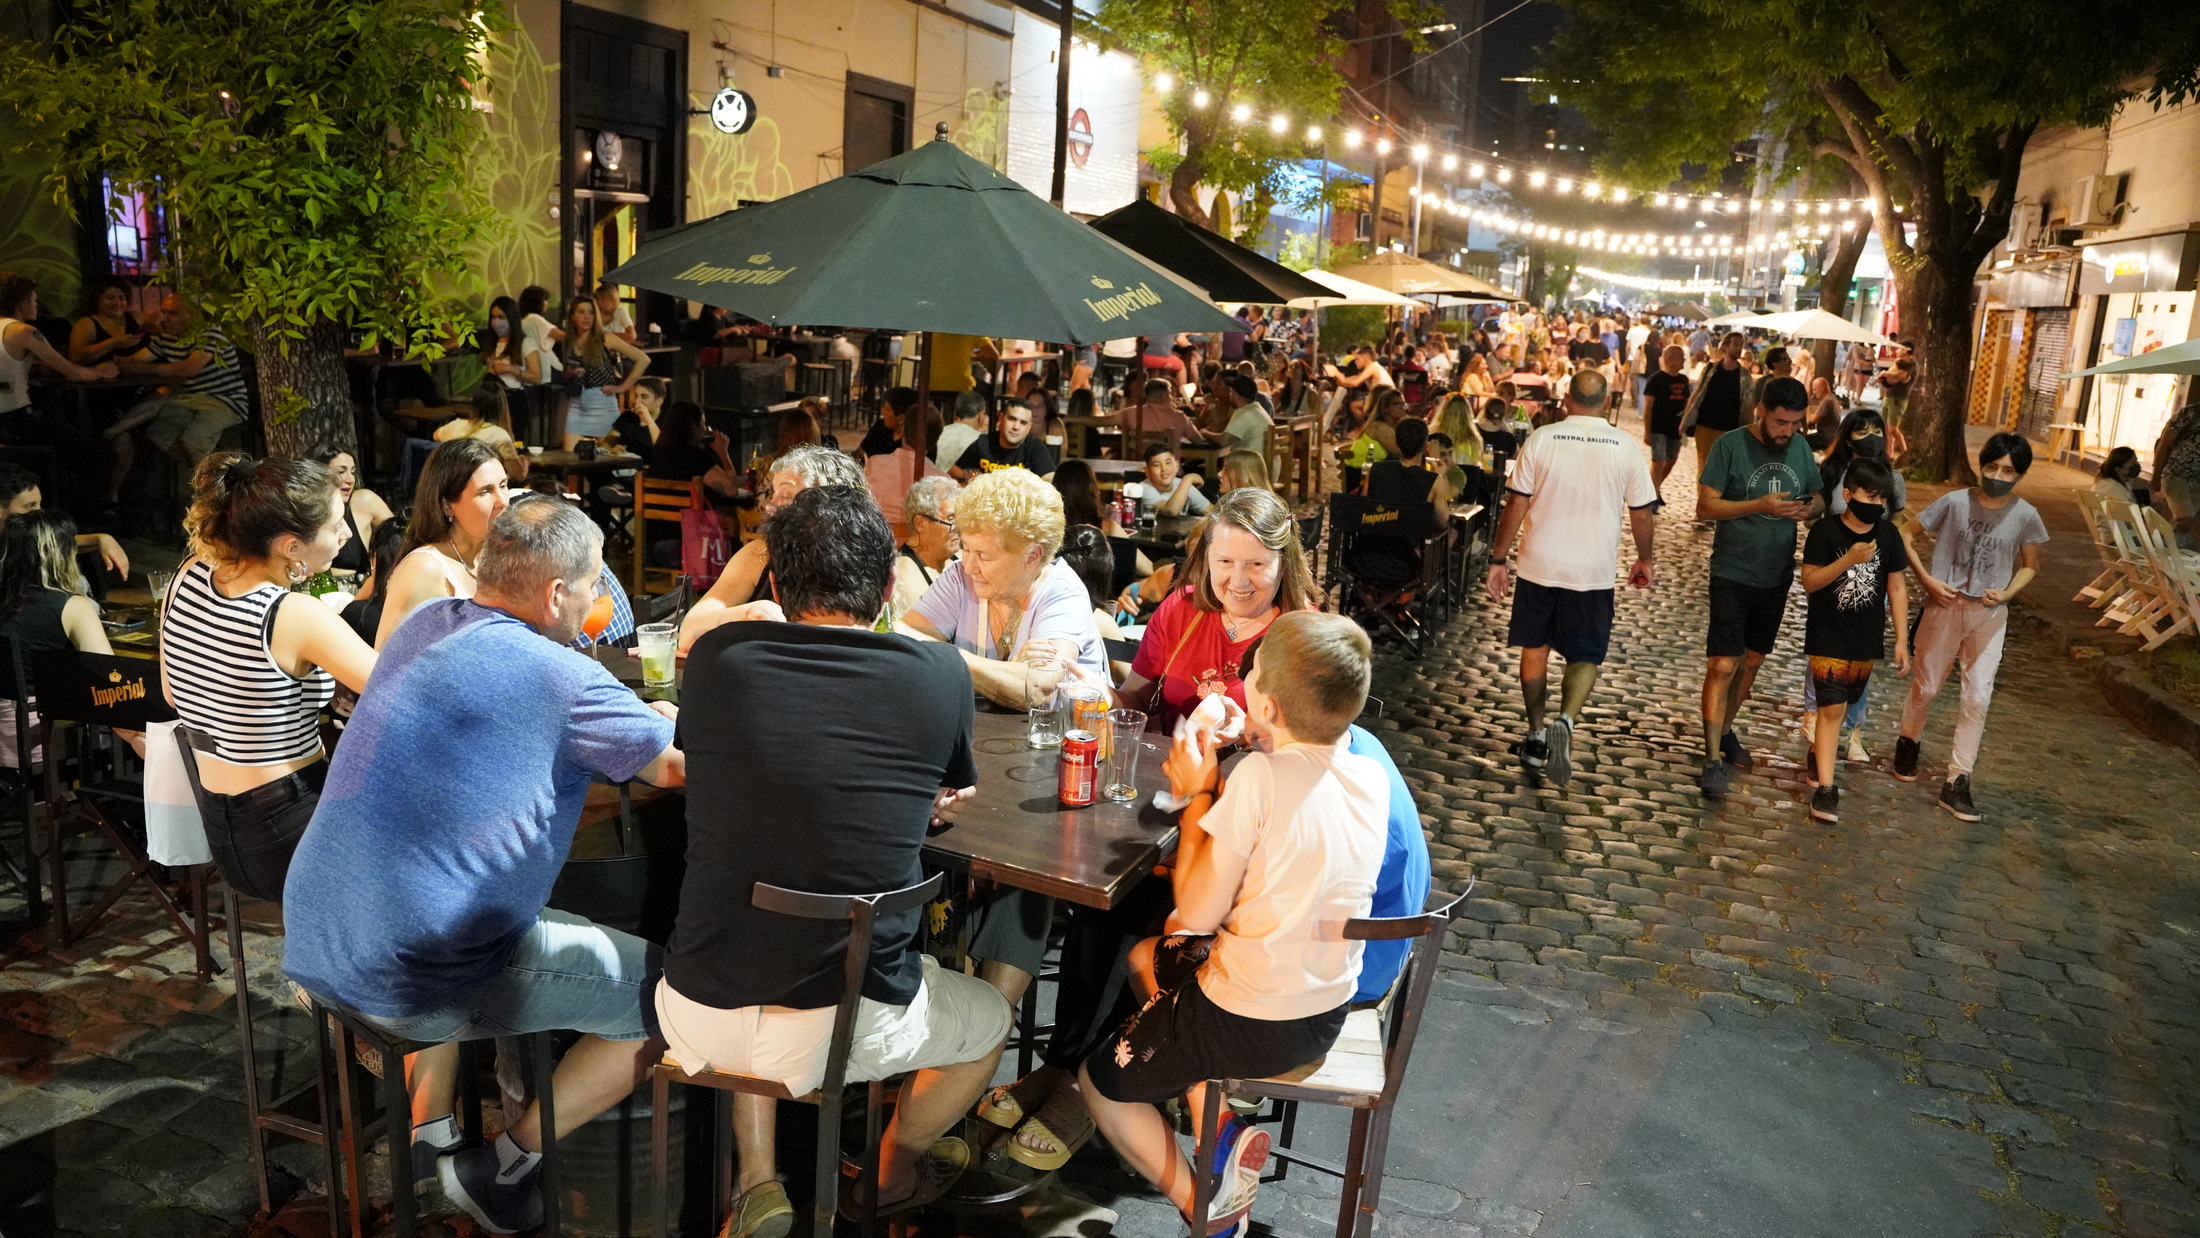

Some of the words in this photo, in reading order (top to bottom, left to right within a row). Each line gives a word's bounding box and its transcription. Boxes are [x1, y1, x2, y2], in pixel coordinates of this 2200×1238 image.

[672, 261, 798, 286] Imperial
[1082, 282, 1162, 322] Imperial
[1553, 434, 1585, 442] CENTRAL
[1586, 437, 1619, 446] BALLESTER
[980, 459, 1026, 474] Reek
[1750, 467, 1768, 488] ROAD
[1769, 465, 1799, 488] RUNNER
[1361, 510, 1399, 525] Imperial
[1967, 518, 1993, 534] YOU
[90, 677, 146, 708] Imperial
